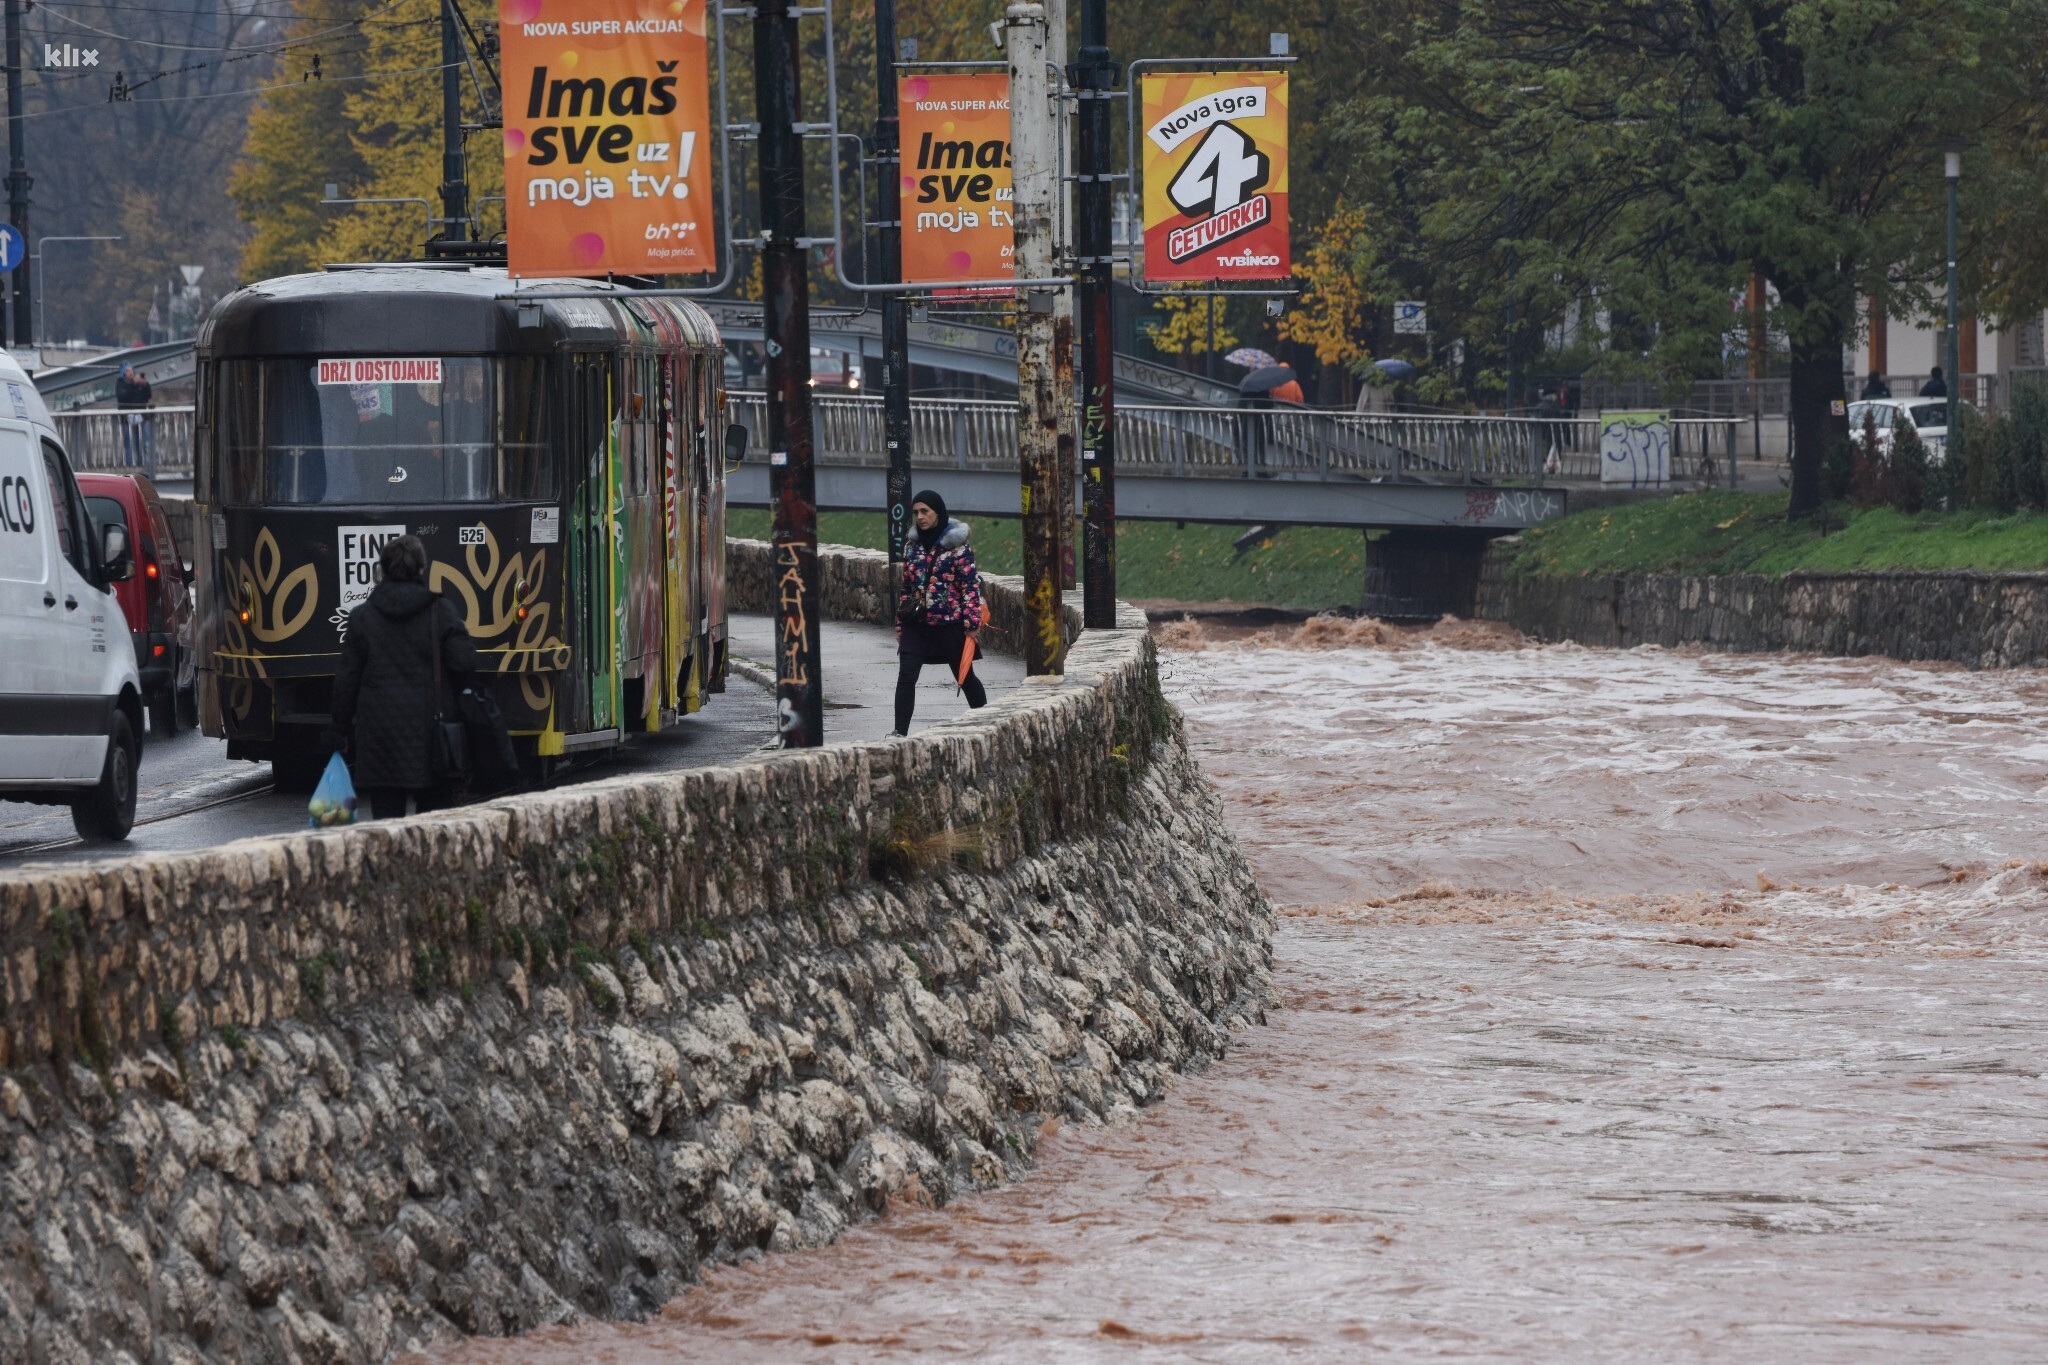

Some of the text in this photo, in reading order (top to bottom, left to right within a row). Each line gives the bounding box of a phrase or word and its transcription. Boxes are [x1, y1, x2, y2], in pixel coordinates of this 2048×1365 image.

[523, 19, 683, 37] NOVA SUPER AKCIJA!
[527, 60, 680, 119] Imaš
[915, 101, 948, 111] NOVA
[950, 100, 986, 110] SUPER
[1159, 95, 1257, 140] Nova igra
[527, 124, 671, 166] sve uz
[1169, 122, 1262, 216] 4
[528, 169, 614, 207] moja
[917, 174, 994, 203] sve
[645, 223, 671, 240] bh
[917, 206, 979, 233] moja
[1171, 197, 1265, 258] ČETVORKA
[647, 248, 669, 259] Moja
[320, 360, 439, 383] DRŽI ODSTOJANJE
[344, 533, 400, 560] FIN
[461, 529, 484, 543] 525
